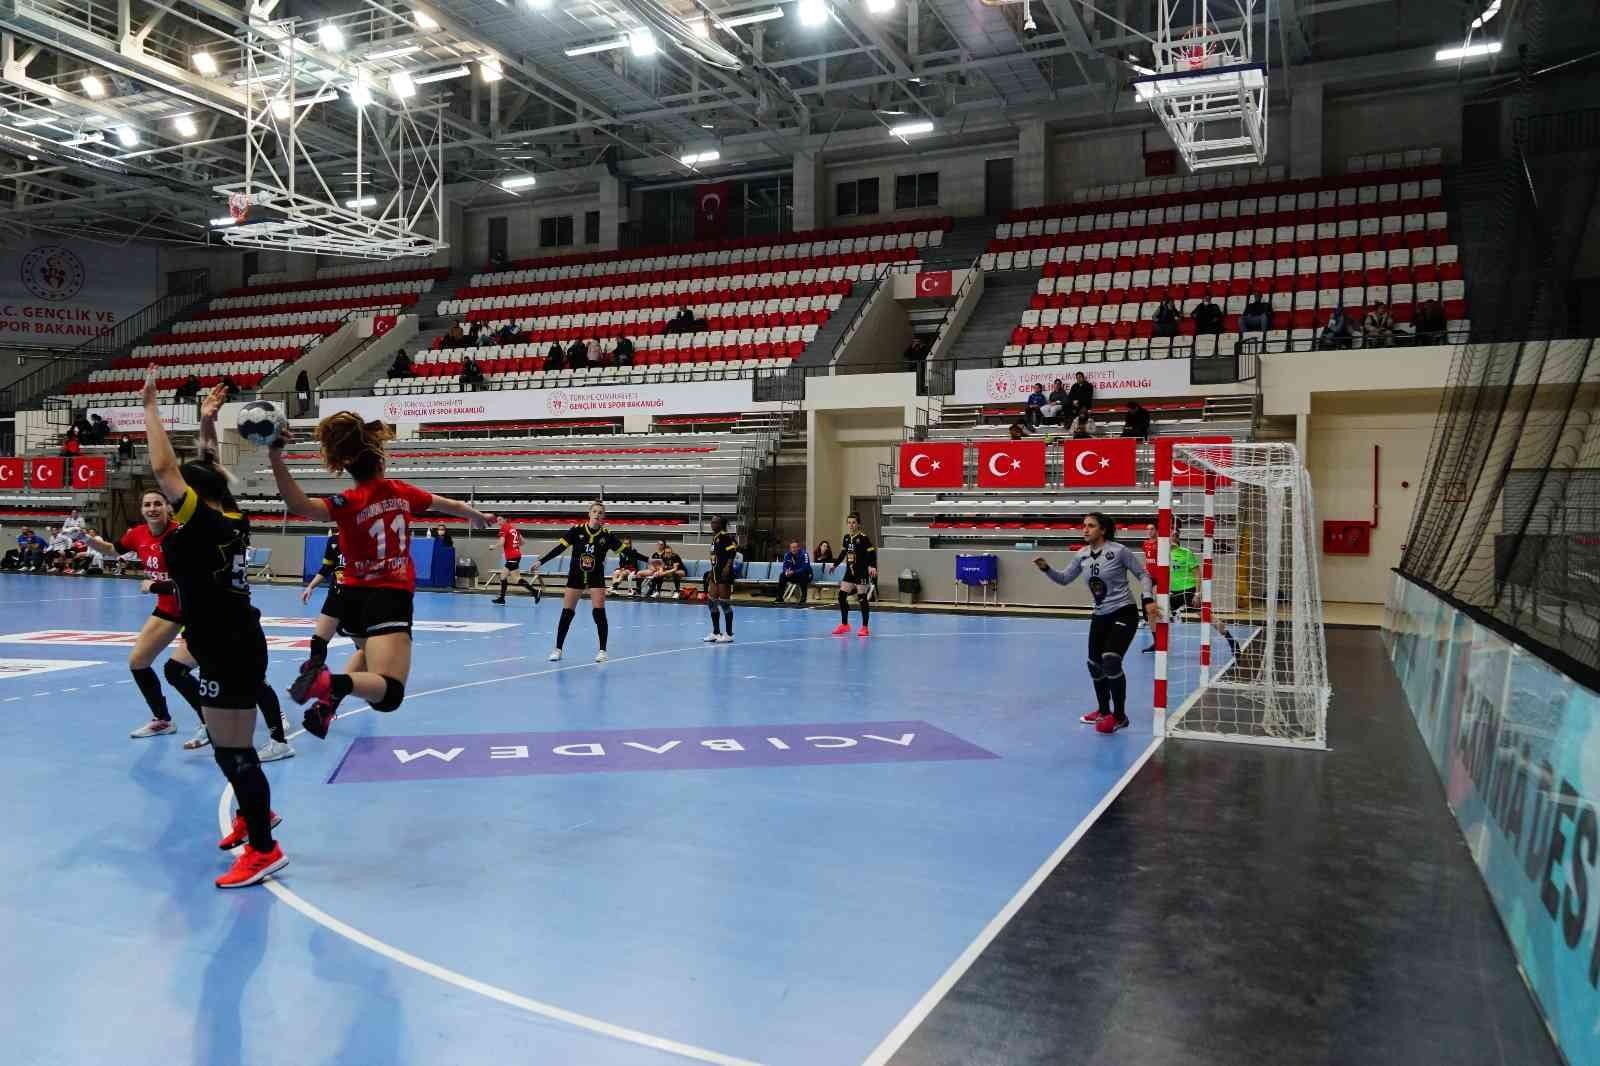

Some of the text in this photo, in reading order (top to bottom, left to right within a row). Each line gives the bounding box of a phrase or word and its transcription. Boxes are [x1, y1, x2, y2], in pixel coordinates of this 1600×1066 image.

[23, 306, 90, 321] GENÇLİK
[95, 311, 114, 322] VE
[0, 320, 31, 334] POR
[368, 513, 408, 560] 11
[146, 555, 159, 569] 48
[1089, 563, 1100, 576] 16
[199, 678, 220, 698] 59
[392, 732, 916, 764] ACIBADEM
